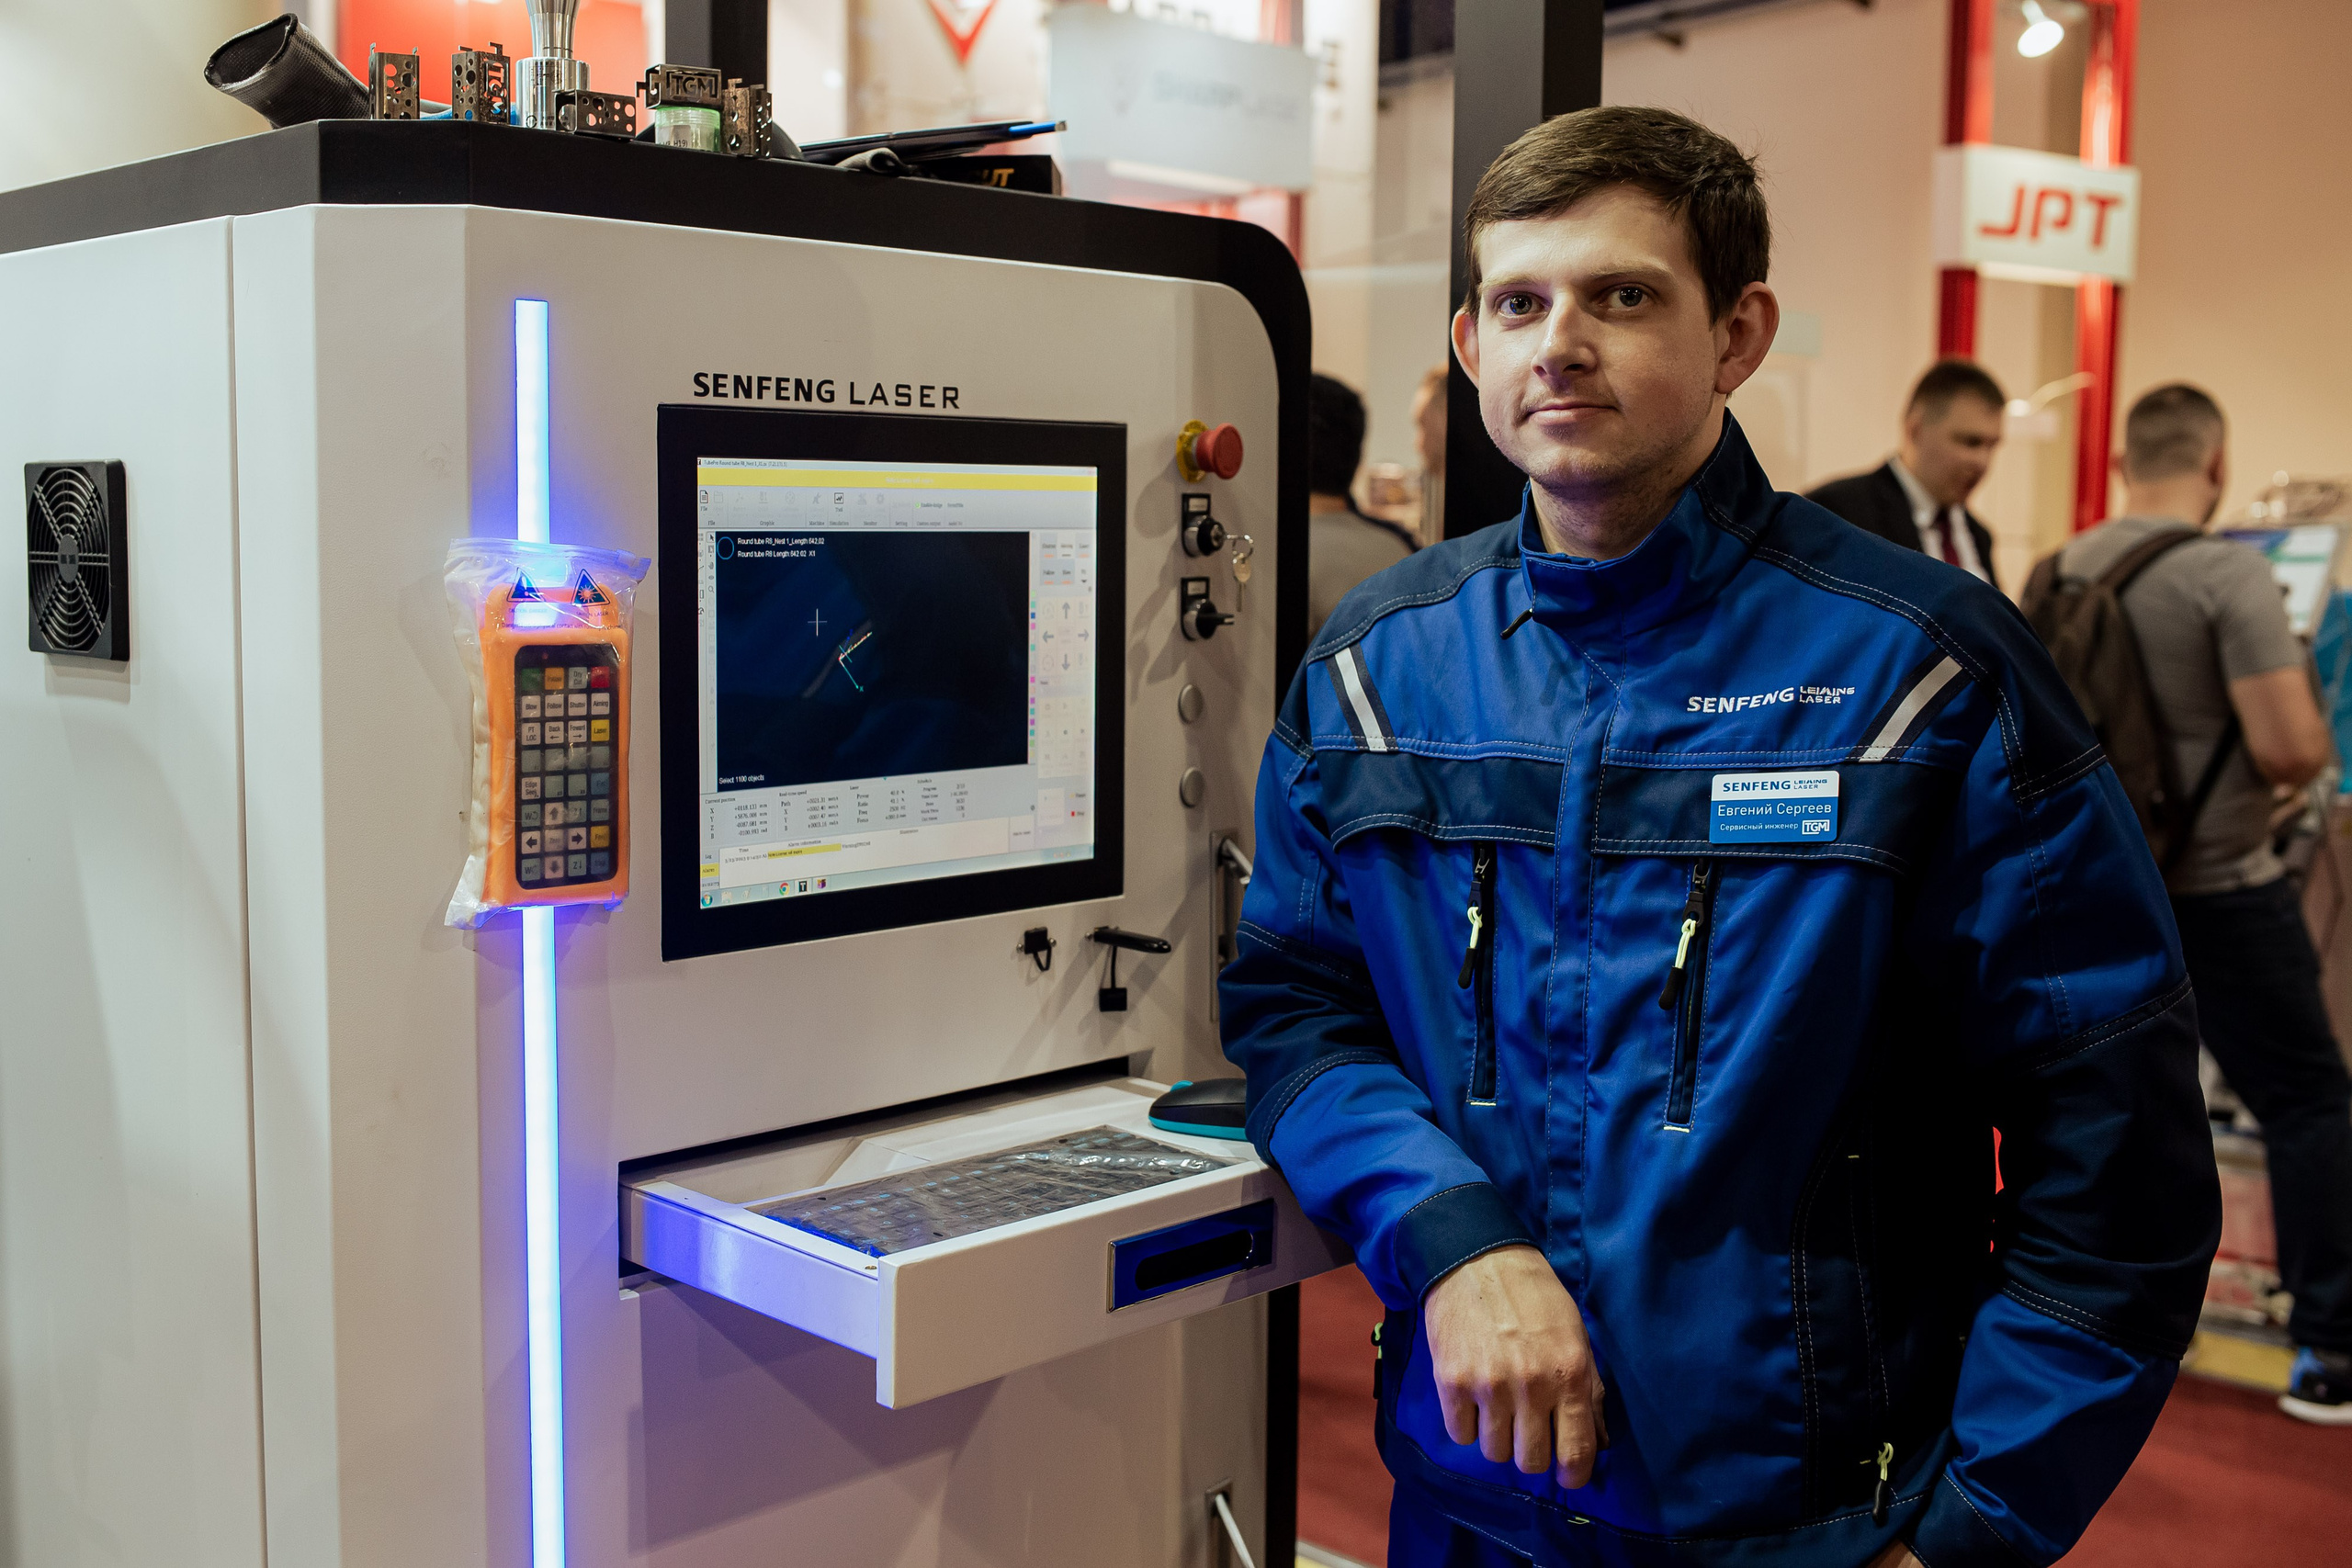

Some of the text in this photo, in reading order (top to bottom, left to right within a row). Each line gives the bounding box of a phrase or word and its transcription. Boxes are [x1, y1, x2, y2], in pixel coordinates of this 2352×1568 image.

[672, 75, 714, 96] TGM
[1979, 184, 2122, 247] JPT
[693, 372, 960, 409] SENFENG LASER
[1799, 685, 1855, 696] LEIMING
[1687, 687, 1794, 713] SENFENG
[1799, 694, 1841, 705] LASER
[748, 774, 764, 783] objects
[1723, 780, 1791, 792] SENFENG
[1717, 802, 1832, 817] Евгений Сергеев
[1720, 822, 1799, 832] Сервисный инженер
[1804, 821, 1827, 832] TGM
